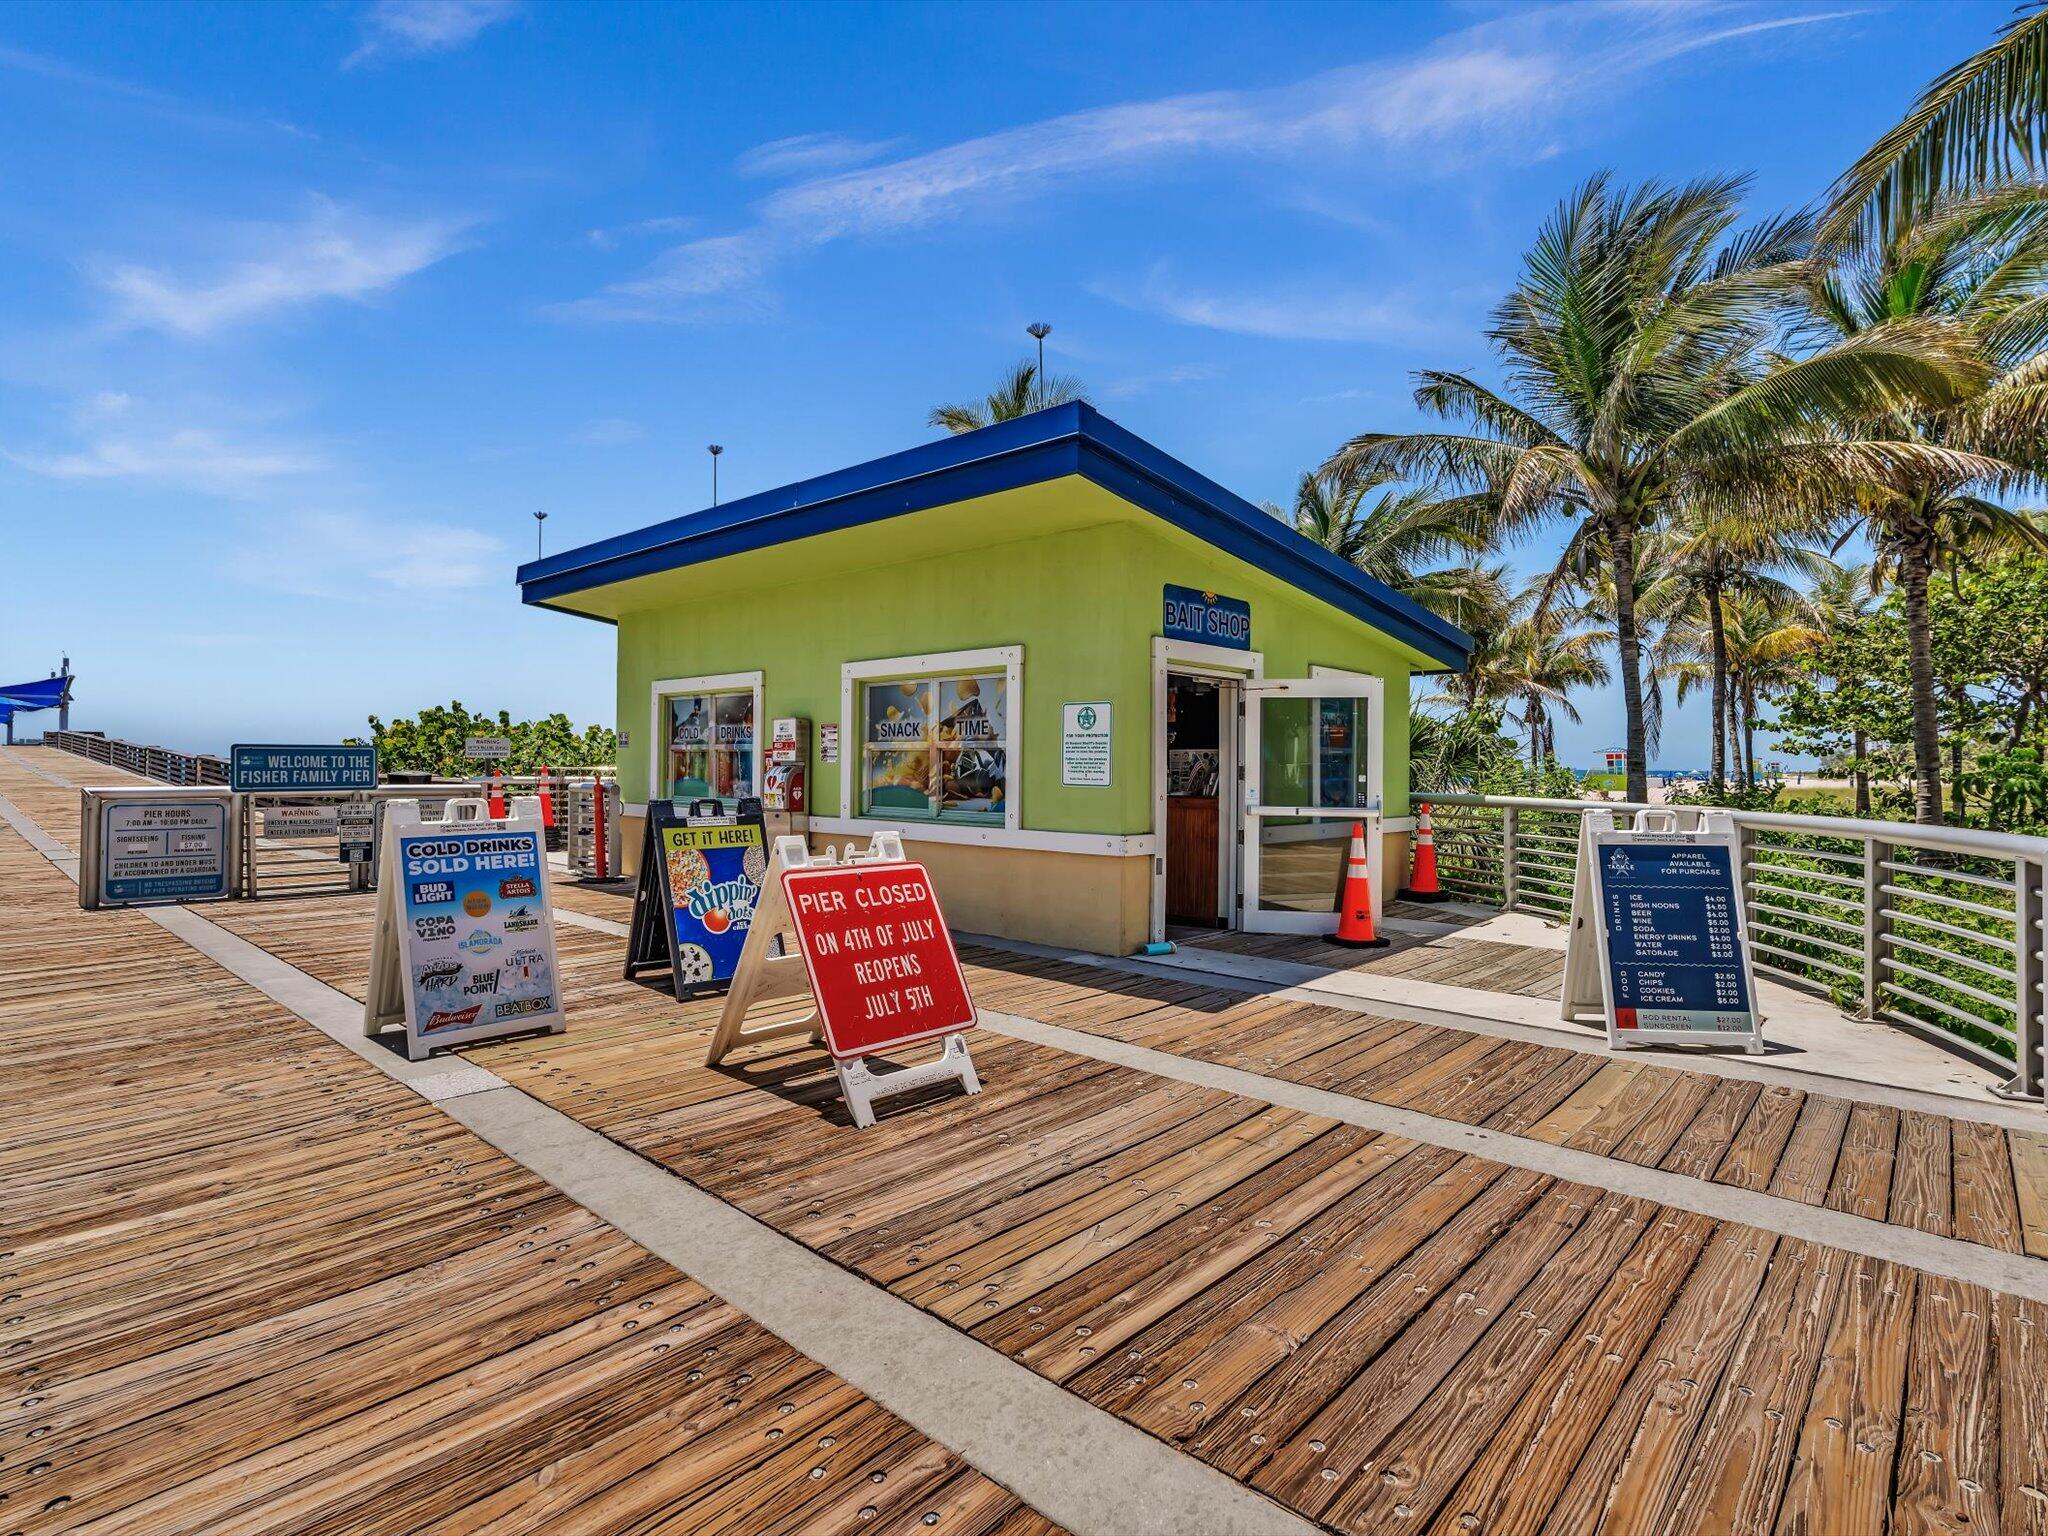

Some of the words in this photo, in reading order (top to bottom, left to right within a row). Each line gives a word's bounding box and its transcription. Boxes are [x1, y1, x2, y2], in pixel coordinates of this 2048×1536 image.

[1165, 602, 1204, 631] BAIT
[1208, 609, 1250, 640] SHOP
[679, 727, 699, 740] COLD
[720, 726, 752, 739] DRINKS
[880, 722, 920, 737] SNACK
[956, 719, 989, 736] TIME
[268, 755, 328, 768] WELCOME
[331, 755, 345, 768] TO
[349, 755, 370, 768] THE
[240, 770, 289, 784] FISHER
[293, 769, 338, 783] FAMILY
[342, 769, 370, 782] PIER
[144, 810, 162, 818] PIER
[165, 809, 191, 818] HOURS
[281, 809, 320, 817] WARNING
[116, 835, 159, 843] SIGHTSEEING
[672, 832, 697, 847] GET
[719, 828, 754, 844] HERE!
[408, 843, 462, 858] COLD
[466, 839, 533, 854] DRINKS
[114, 860, 148, 870] CHILDREN
[175, 859, 197, 867] UNDER
[408, 858, 469, 876] SOLD
[475, 853, 535, 870] HERE!
[124, 868, 169, 876] ACCOMPANIED
[1679, 868, 1721, 876] PURCHASE
[420, 883, 447, 893] BUD
[507, 887, 530, 895] ARTOIS
[415, 891, 453, 903] LIGHT
[798, 890, 847, 914] PIER
[855, 882, 927, 908] CLOSED
[728, 905, 753, 920] dots
[1612, 894, 1622, 931] DRINKS
[415, 915, 455, 928] COPA
[504, 919, 539, 929] LANDSHARK
[416, 925, 456, 938] VINO
[815, 932, 839, 956] ON
[844, 928, 873, 951] 4TH
[875, 925, 894, 947] OF
[902, 919, 936, 944] JULY
[458, 936, 503, 950] ISLAMORADA
[505, 954, 543, 967] ULTRA
[854, 954, 922, 985] REOPENS
[424, 976, 458, 991] HARD
[472, 972, 495, 984] BLUE
[1620, 970, 1629, 998] FOOD
[463, 982, 494, 996] POINT
[496, 996, 551, 1016] BEATBOX
[865, 991, 901, 1020] JULY
[905, 985, 934, 1012] 5TH
[1655, 995, 1683, 1003] CREAM
[429, 1011, 477, 1025] Budweiser
[1643, 1022, 1692, 1030] SUNSCREEN
